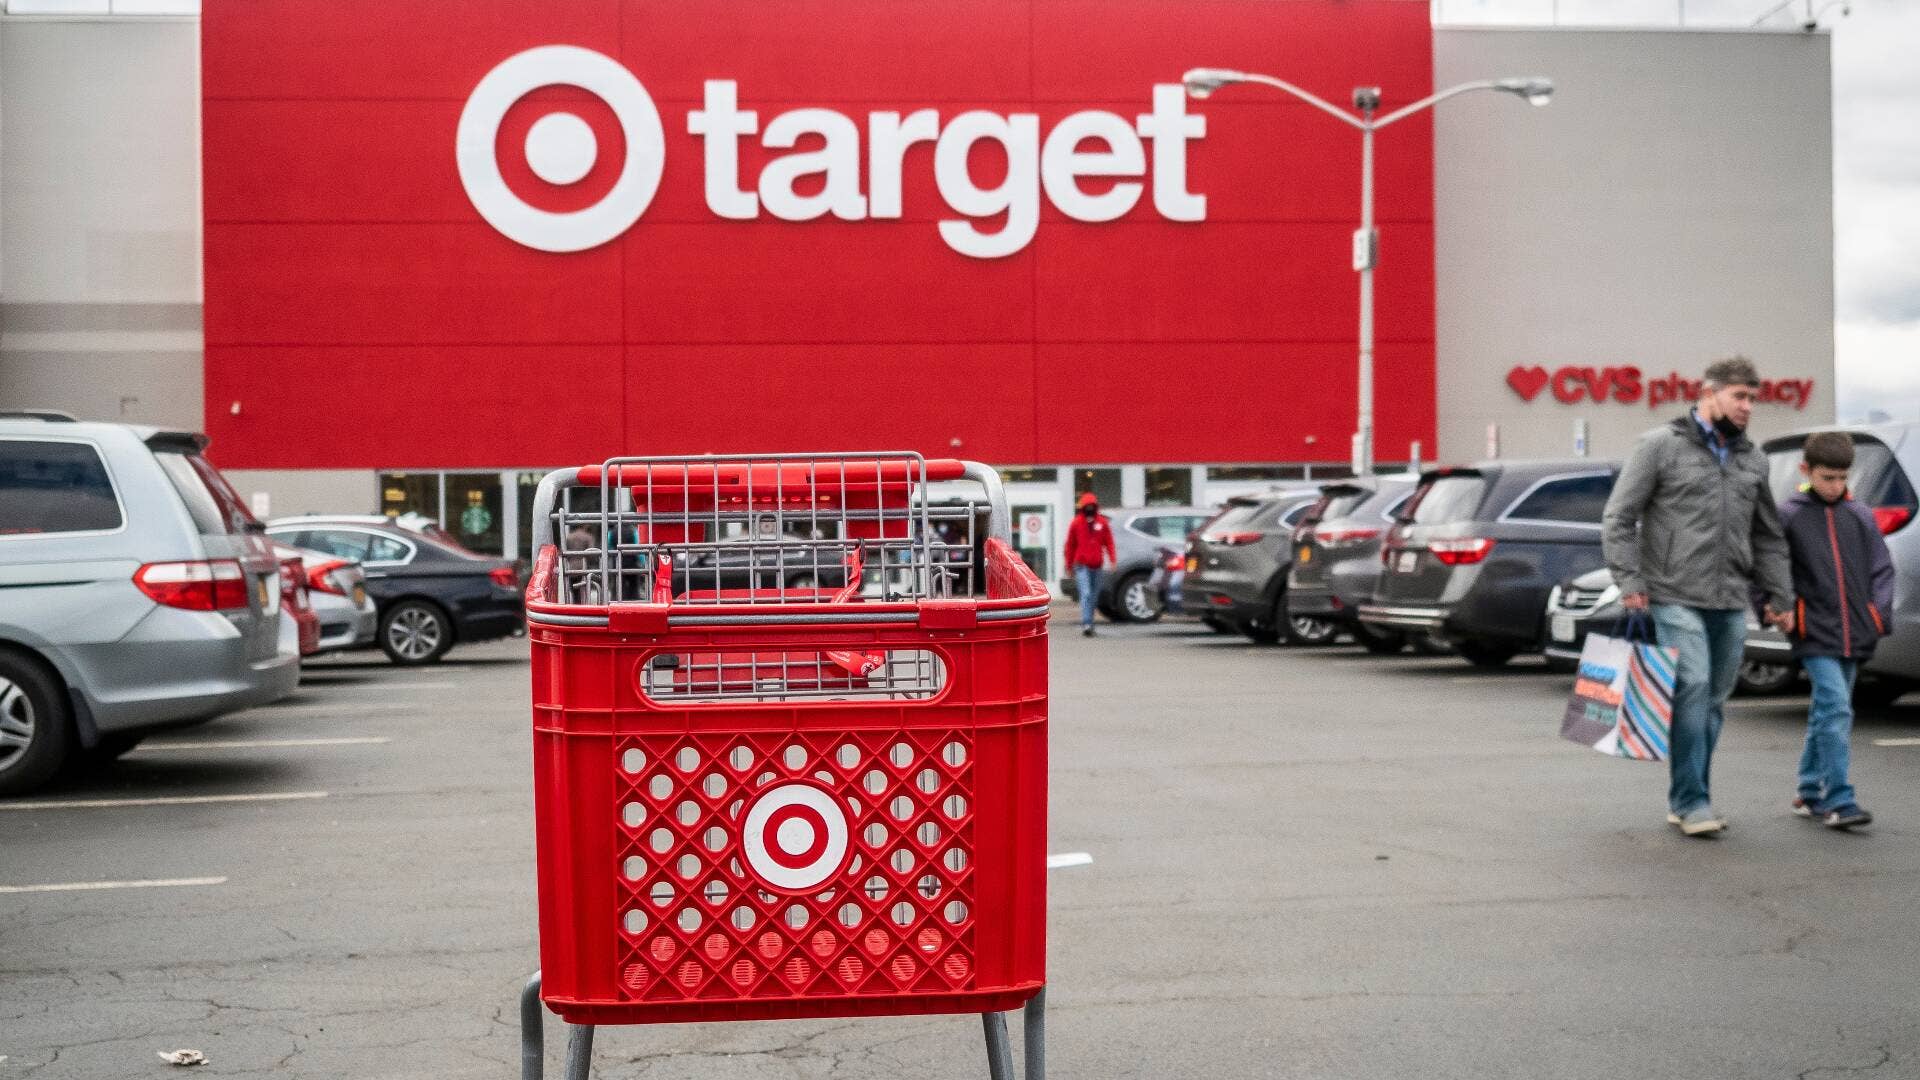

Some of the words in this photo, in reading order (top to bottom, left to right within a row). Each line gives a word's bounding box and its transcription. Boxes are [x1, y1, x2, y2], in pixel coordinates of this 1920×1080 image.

[687, 79, 1207, 258] target
[1551, 365, 1644, 404] CVS
[1648, 372, 1814, 410] phaacy
